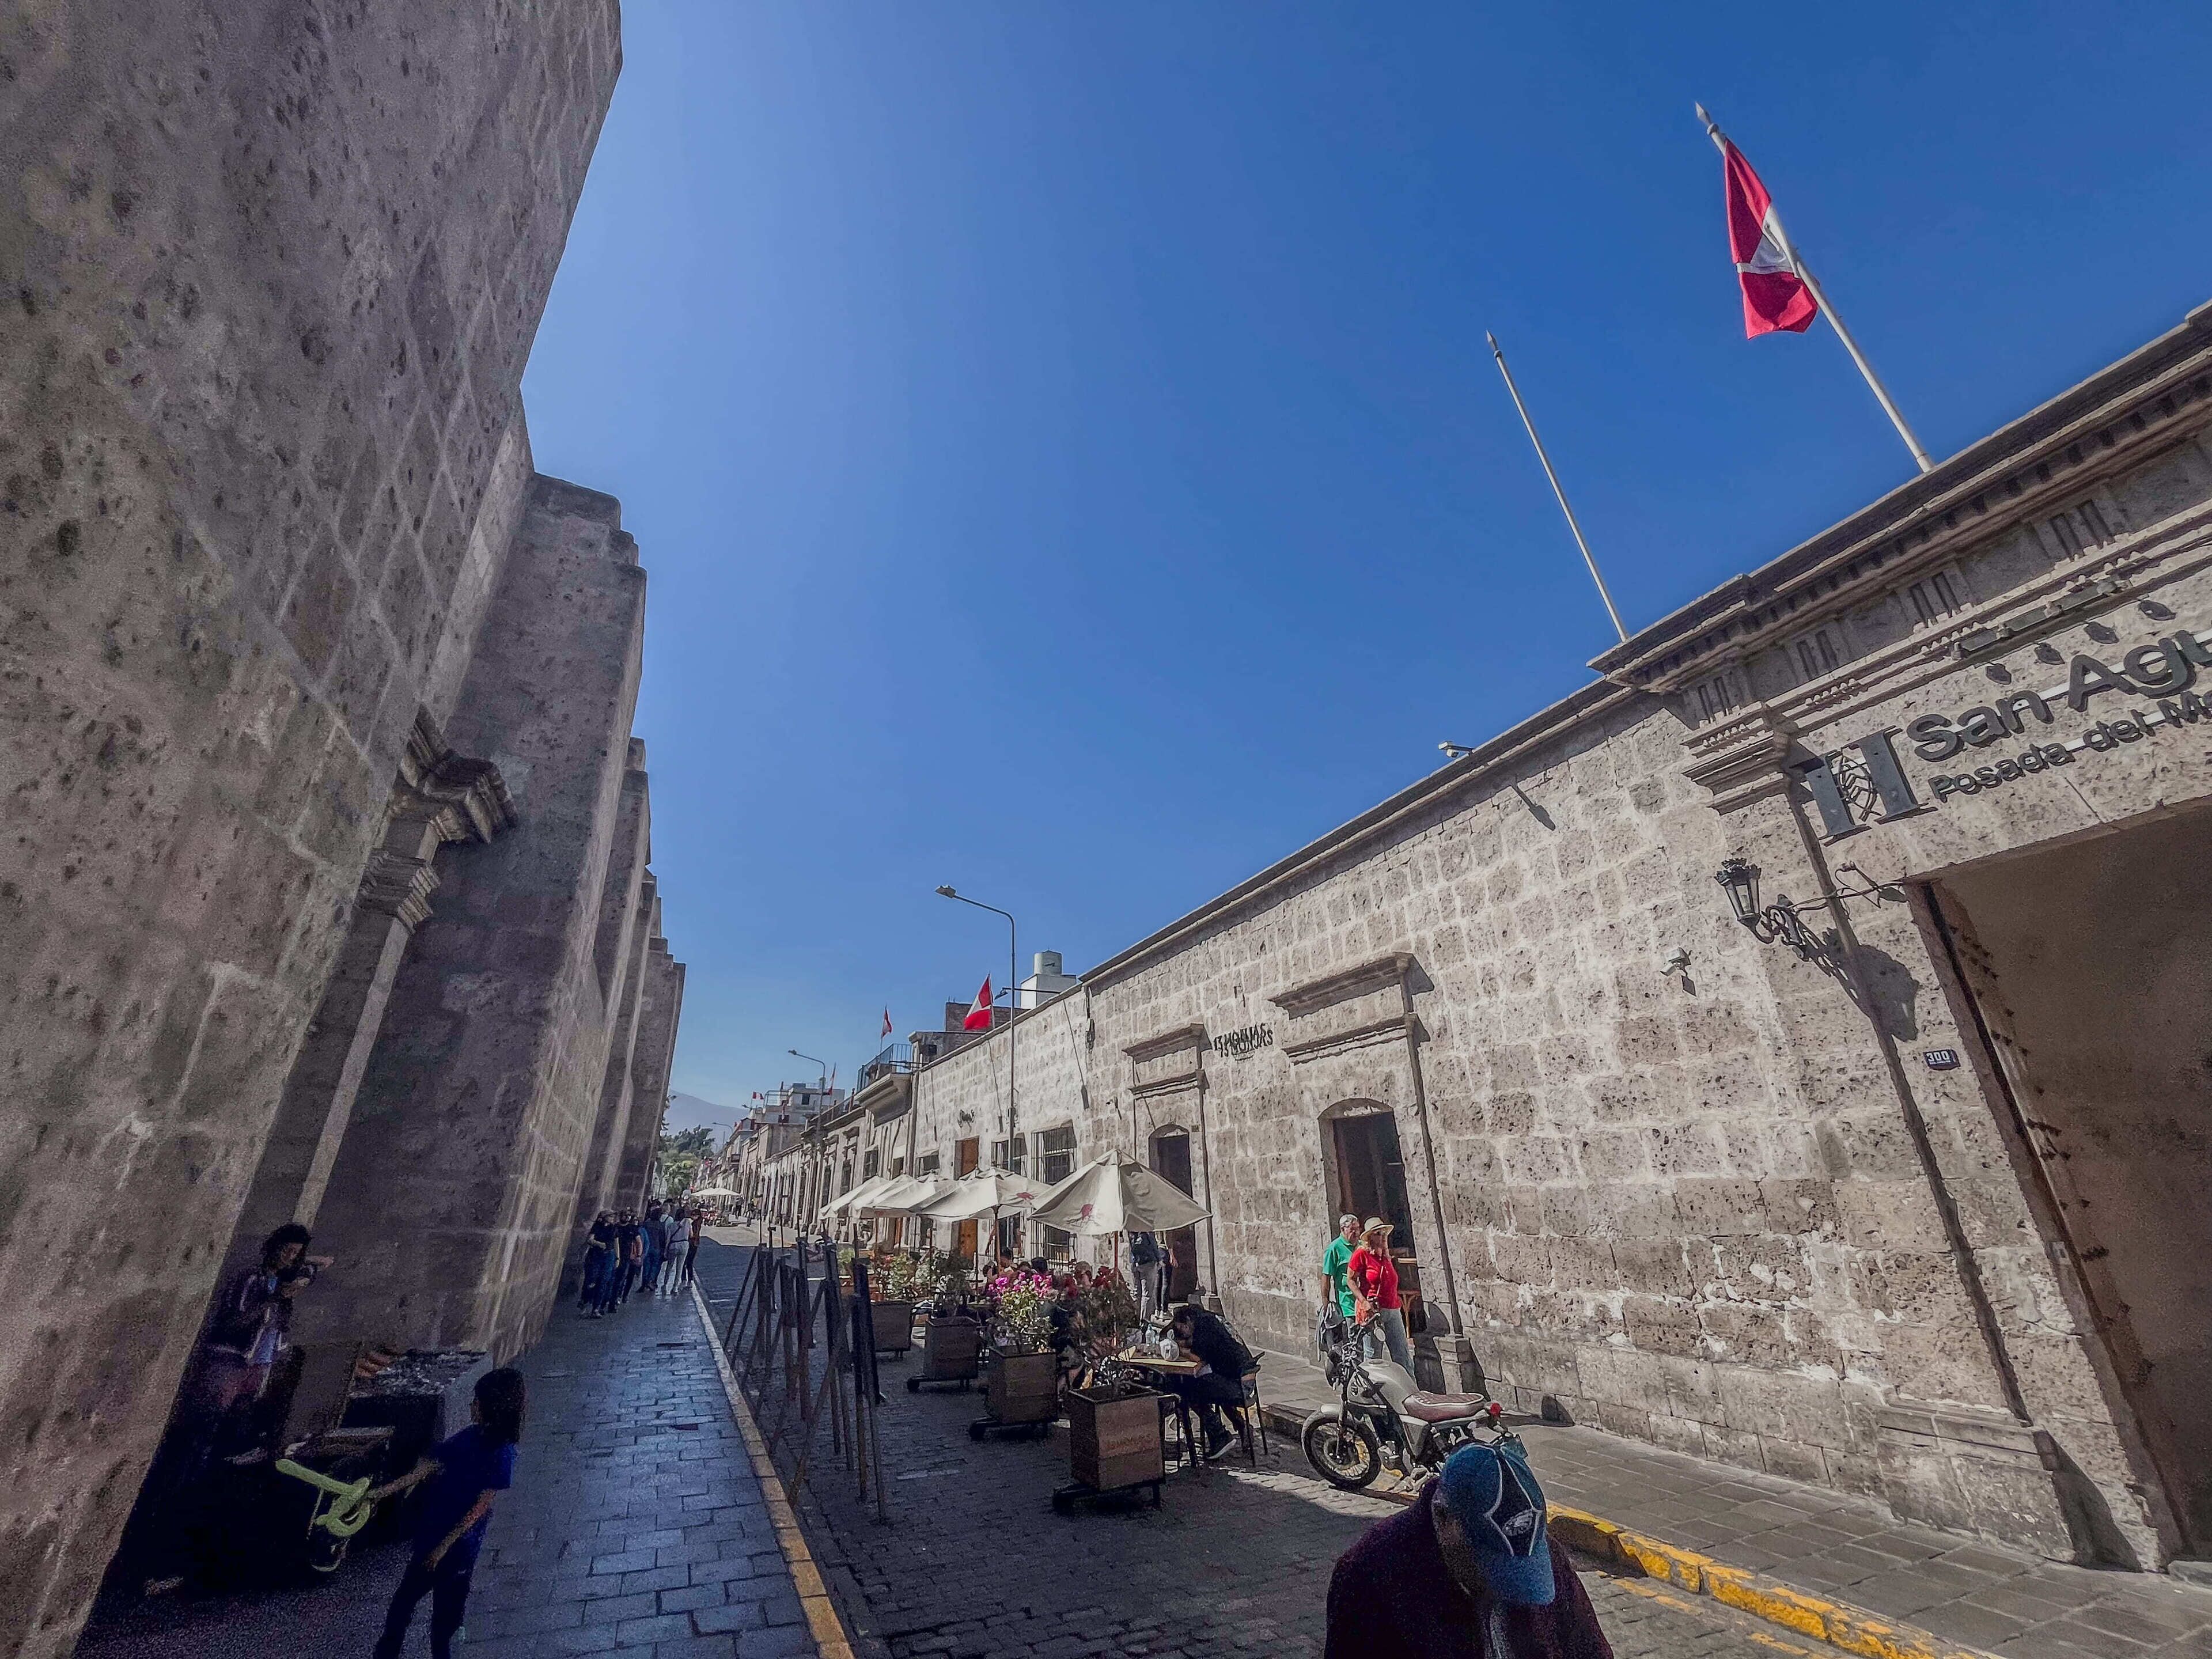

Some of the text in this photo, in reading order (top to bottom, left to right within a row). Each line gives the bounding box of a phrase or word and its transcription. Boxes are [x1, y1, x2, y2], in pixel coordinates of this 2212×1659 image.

[1907, 690, 2053, 762] San
[1929, 743, 2074, 803] Posada
[2083, 709, 2155, 751] del
[1926, 1051, 1950, 1062] 300
